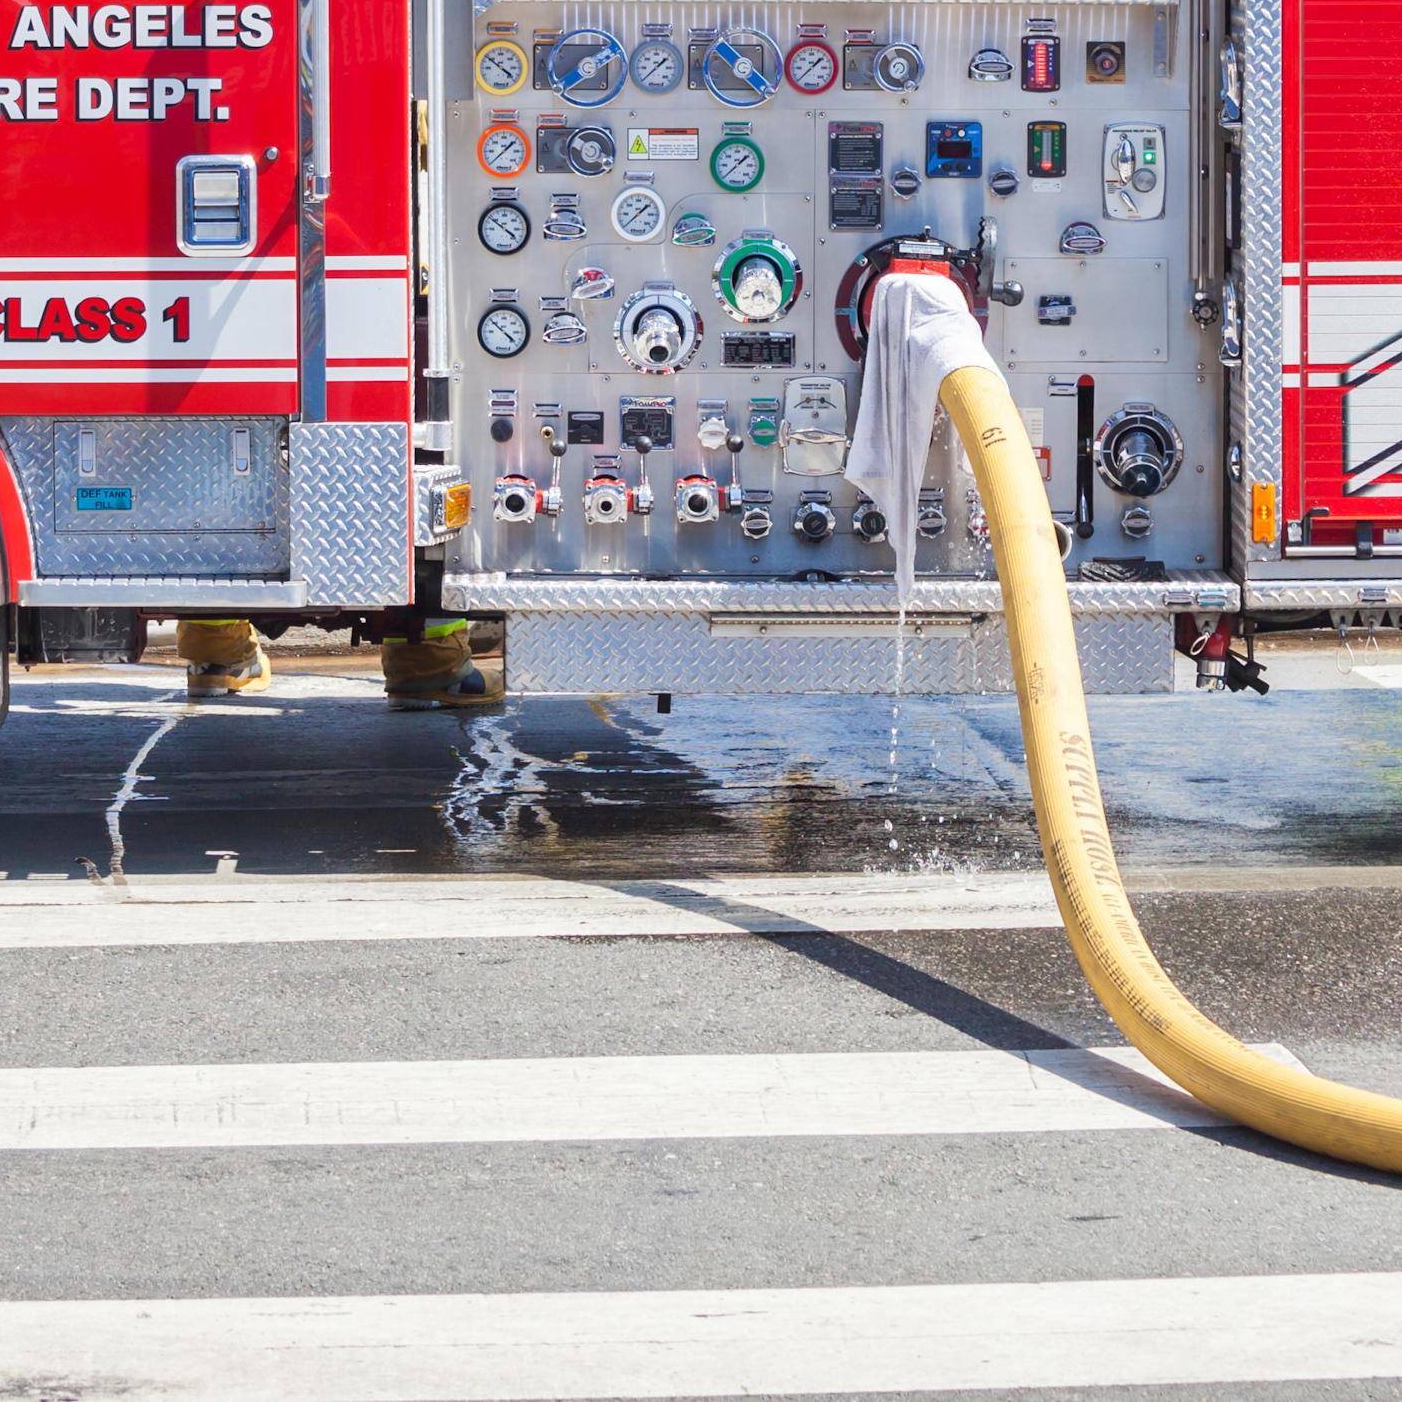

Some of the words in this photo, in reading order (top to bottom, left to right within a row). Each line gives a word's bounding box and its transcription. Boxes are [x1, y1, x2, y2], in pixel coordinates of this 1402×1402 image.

[8, 4, 274, 51] ANGELES
[75, 77, 230, 123] DEPT.
[163, 296, 190, 343] 1
[81, 489, 101, 498] DEF
[95, 501, 113, 510] FILL
[1058, 728, 1103, 826] SUPPLY
[1079, 828, 1124, 891] HOSE
